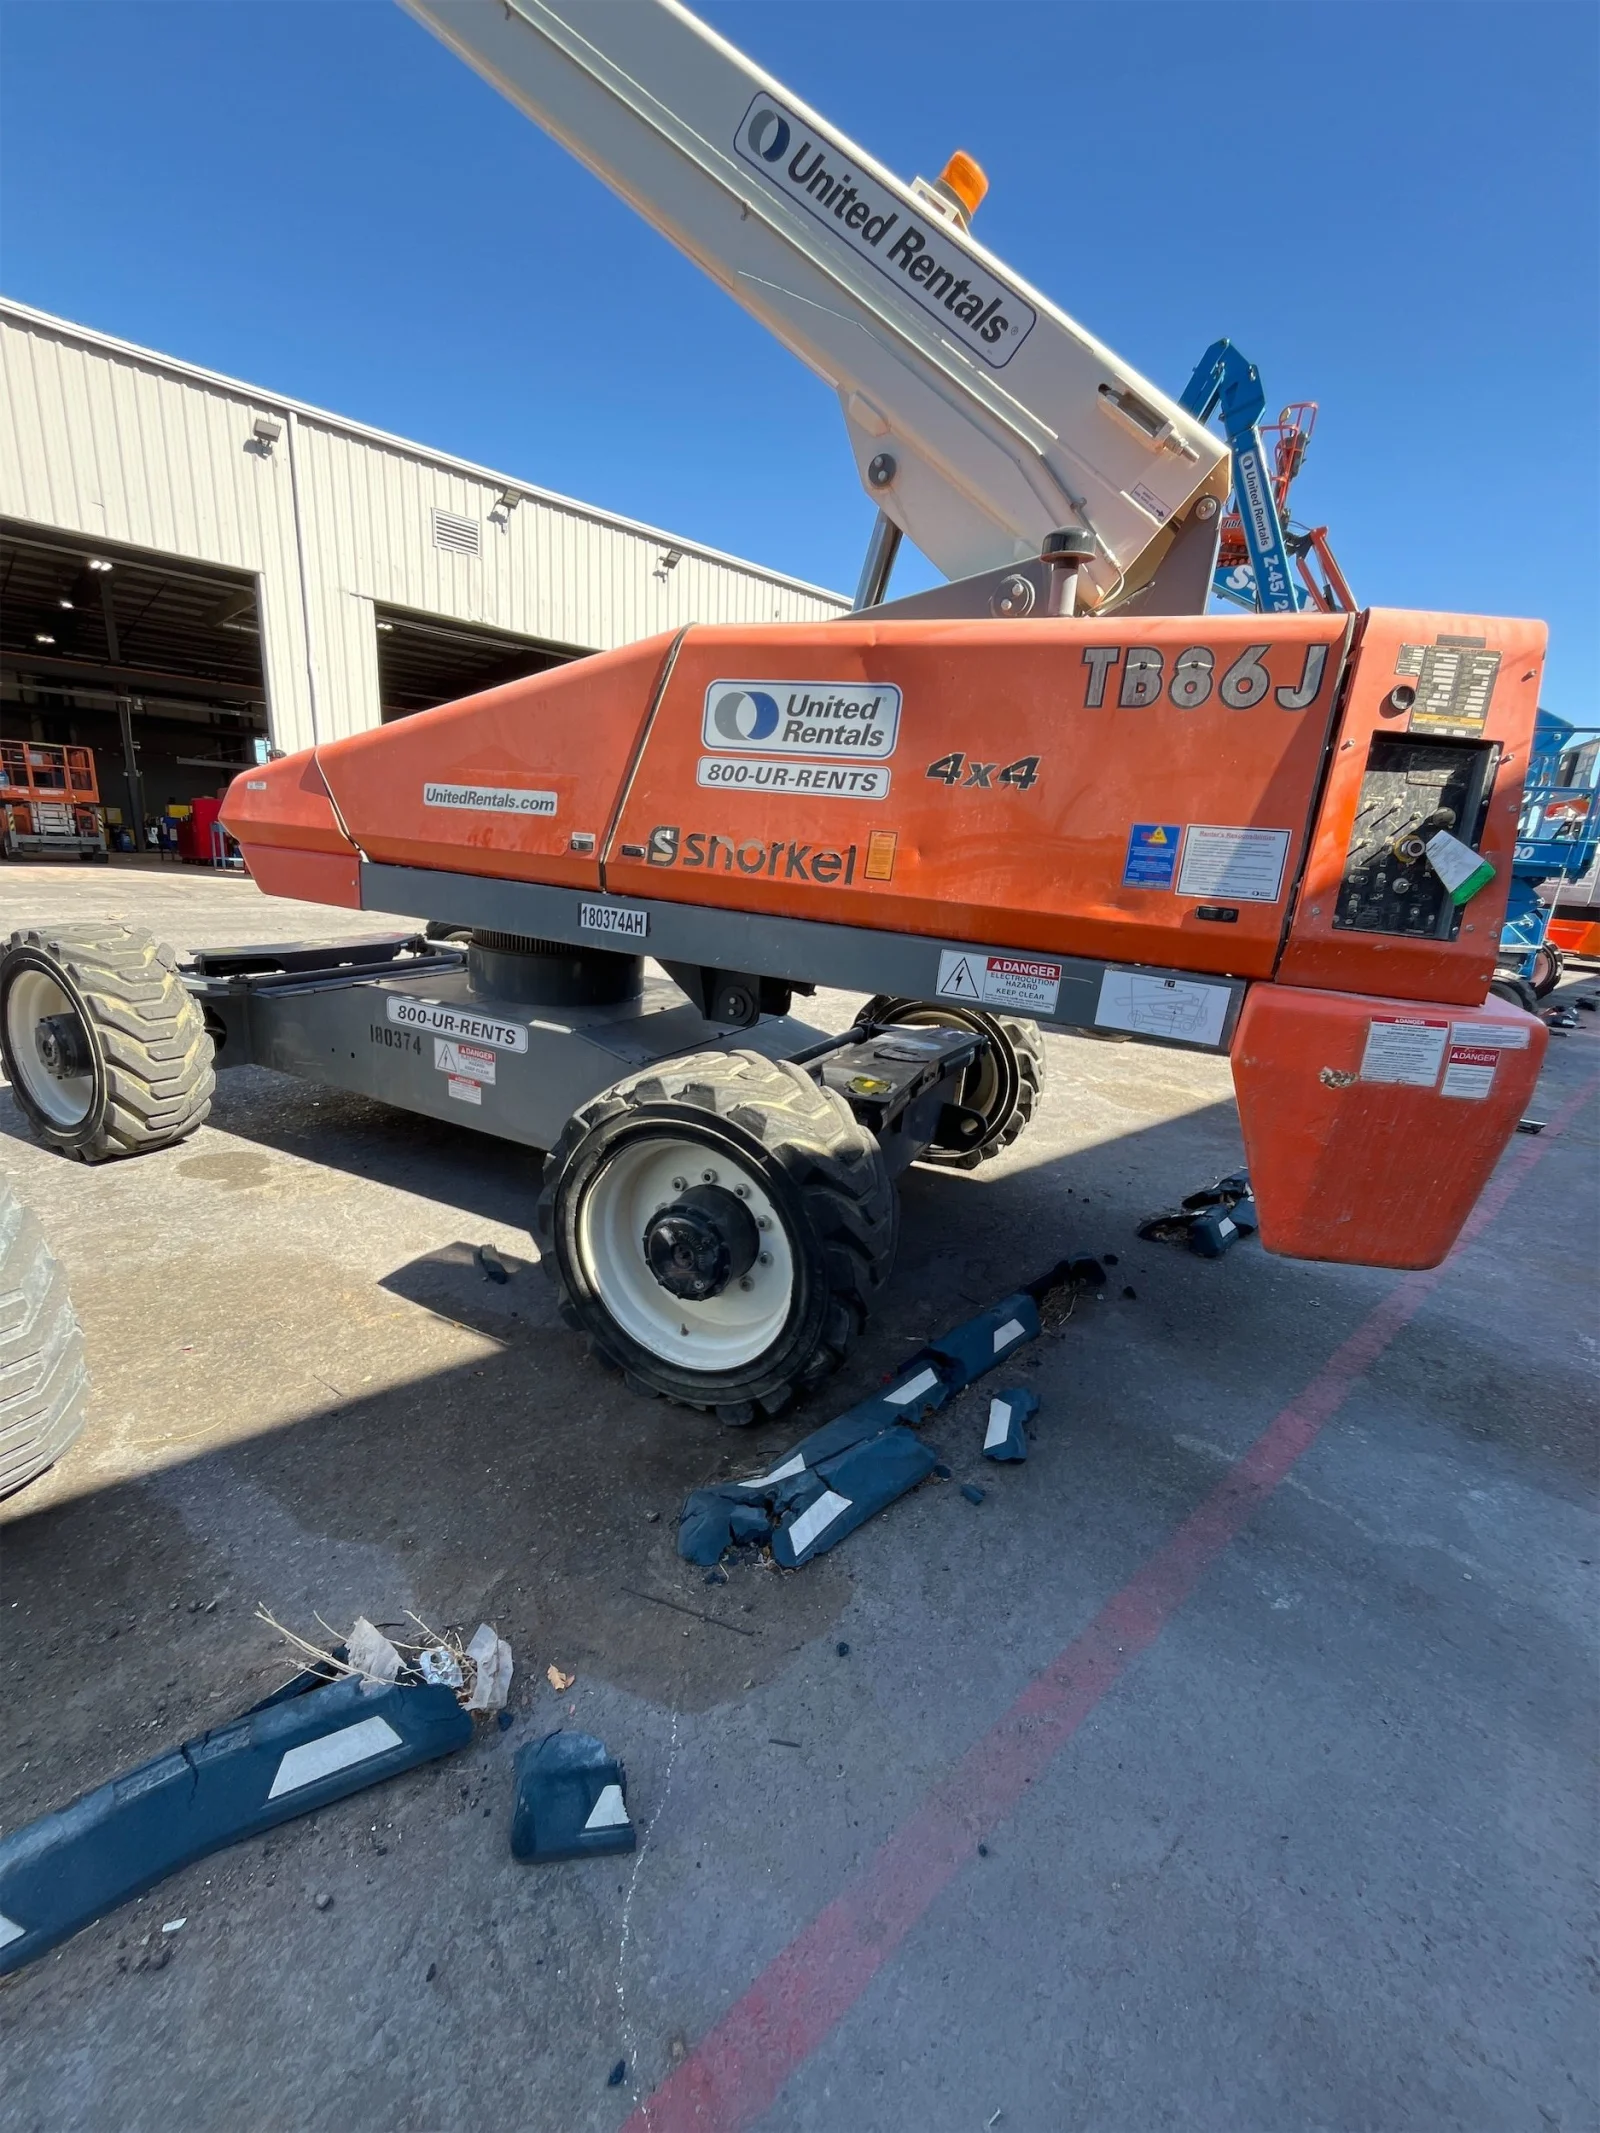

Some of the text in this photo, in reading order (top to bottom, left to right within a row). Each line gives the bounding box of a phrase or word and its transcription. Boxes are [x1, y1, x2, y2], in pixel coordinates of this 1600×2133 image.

[788, 141, 1010, 344] United Rentals
[1246, 471, 1270, 546] United Rentals
[1263, 554, 1291, 612] Z-45/2
[1082, 643, 1330, 711] TB86J
[786, 694, 883, 720] United
[782, 720, 885, 747] Rentals
[707, 764, 878, 792] 800-UR-RENTS
[925, 752, 1042, 791] 4x4
[426, 788, 555, 812] UnitedRentals.com
[582, 906, 644, 935] 180374AH
[990, 972, 1055, 987] ELECTROCUTION
[1002, 961, 1056, 977] DANGER
[1005, 981, 1038, 990] HAZARD
[1018, 991, 1044, 1000] CLEAR
[398, 1005, 516, 1045] 800-UR-RENTS
[370, 1024, 422, 1055] 180374
[465, 1047, 493, 1060] DANGER
[1459, 1052, 1496, 1061] DANGER
